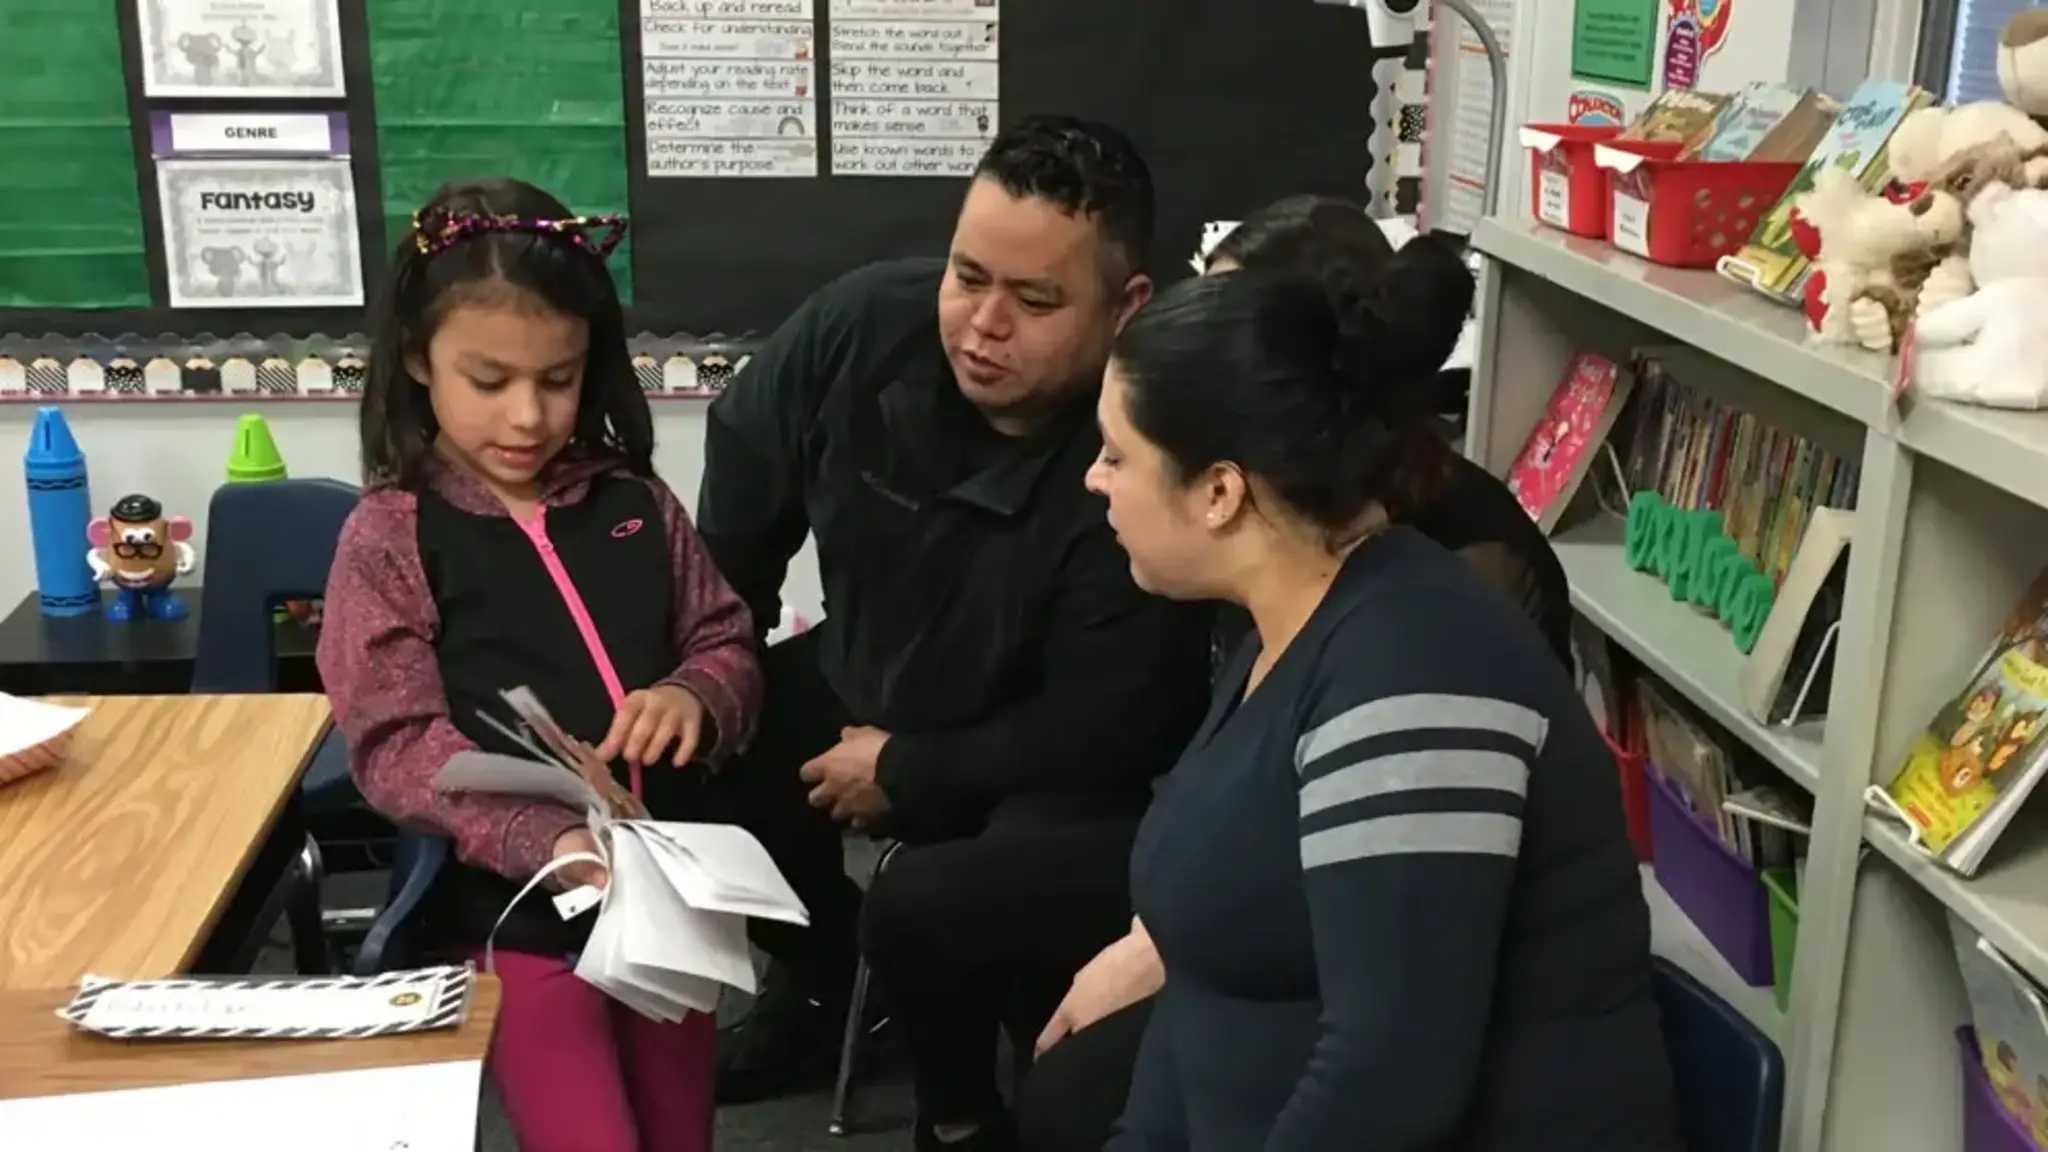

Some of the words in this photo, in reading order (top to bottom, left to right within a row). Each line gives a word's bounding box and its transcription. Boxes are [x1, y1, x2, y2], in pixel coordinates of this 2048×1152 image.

[695, 2, 713, 18] up
[718, 1, 744, 13] and
[750, 1, 802, 13] reread
[644, 22, 685, 34] Check
[722, 23, 812, 38] understanding
[833, 26, 880, 38] Stretch
[885, 27, 904, 38] the
[909, 28, 938, 38] word
[942, 28, 962, 39] out
[870, 41, 889, 51] the
[894, 41, 933, 51] sounds
[939, 42, 989, 58] together
[646, 62, 685, 80] Adjust
[691, 64, 721, 79] your
[727, 63, 776, 81] reading
[780, 64, 808, 75] rate
[832, 63, 861, 80] Skip
[868, 62, 890, 76] the
[898, 65, 934, 77] word
[939, 65, 965, 78] and
[645, 79, 709, 94] depending
[714, 80, 730, 90] on
[736, 78, 757, 90] the
[763, 79, 790, 90] text
[833, 80, 864, 92] then
[869, 82, 909, 93] come
[915, 81, 949, 93] back
[647, 102, 722, 120] Recognize
[728, 103, 771, 115] cause
[777, 103, 803, 115] and
[835, 101, 871, 115] Think
[877, 103, 895, 115] of
[902, 105, 911, 115] a
[916, 103, 951, 116] word
[959, 102, 988, 117] that
[224, 126, 278, 139] GENRE
[647, 120, 700, 131] effect
[834, 119, 879, 131] makes
[885, 121, 926, 132] sense
[650, 142, 723, 154] Determine
[731, 141, 754, 154] the
[834, 144, 859, 155] Use
[864, 144, 907, 155] known
[912, 144, 954, 156] words
[960, 144, 975, 156] to
[651, 158, 709, 170] author's
[714, 159, 774, 174] purpose
[834, 159, 870, 170] work
[875, 159, 896, 170] out
[903, 159, 941, 171] other
[200, 191, 315, 212] Fantasy
